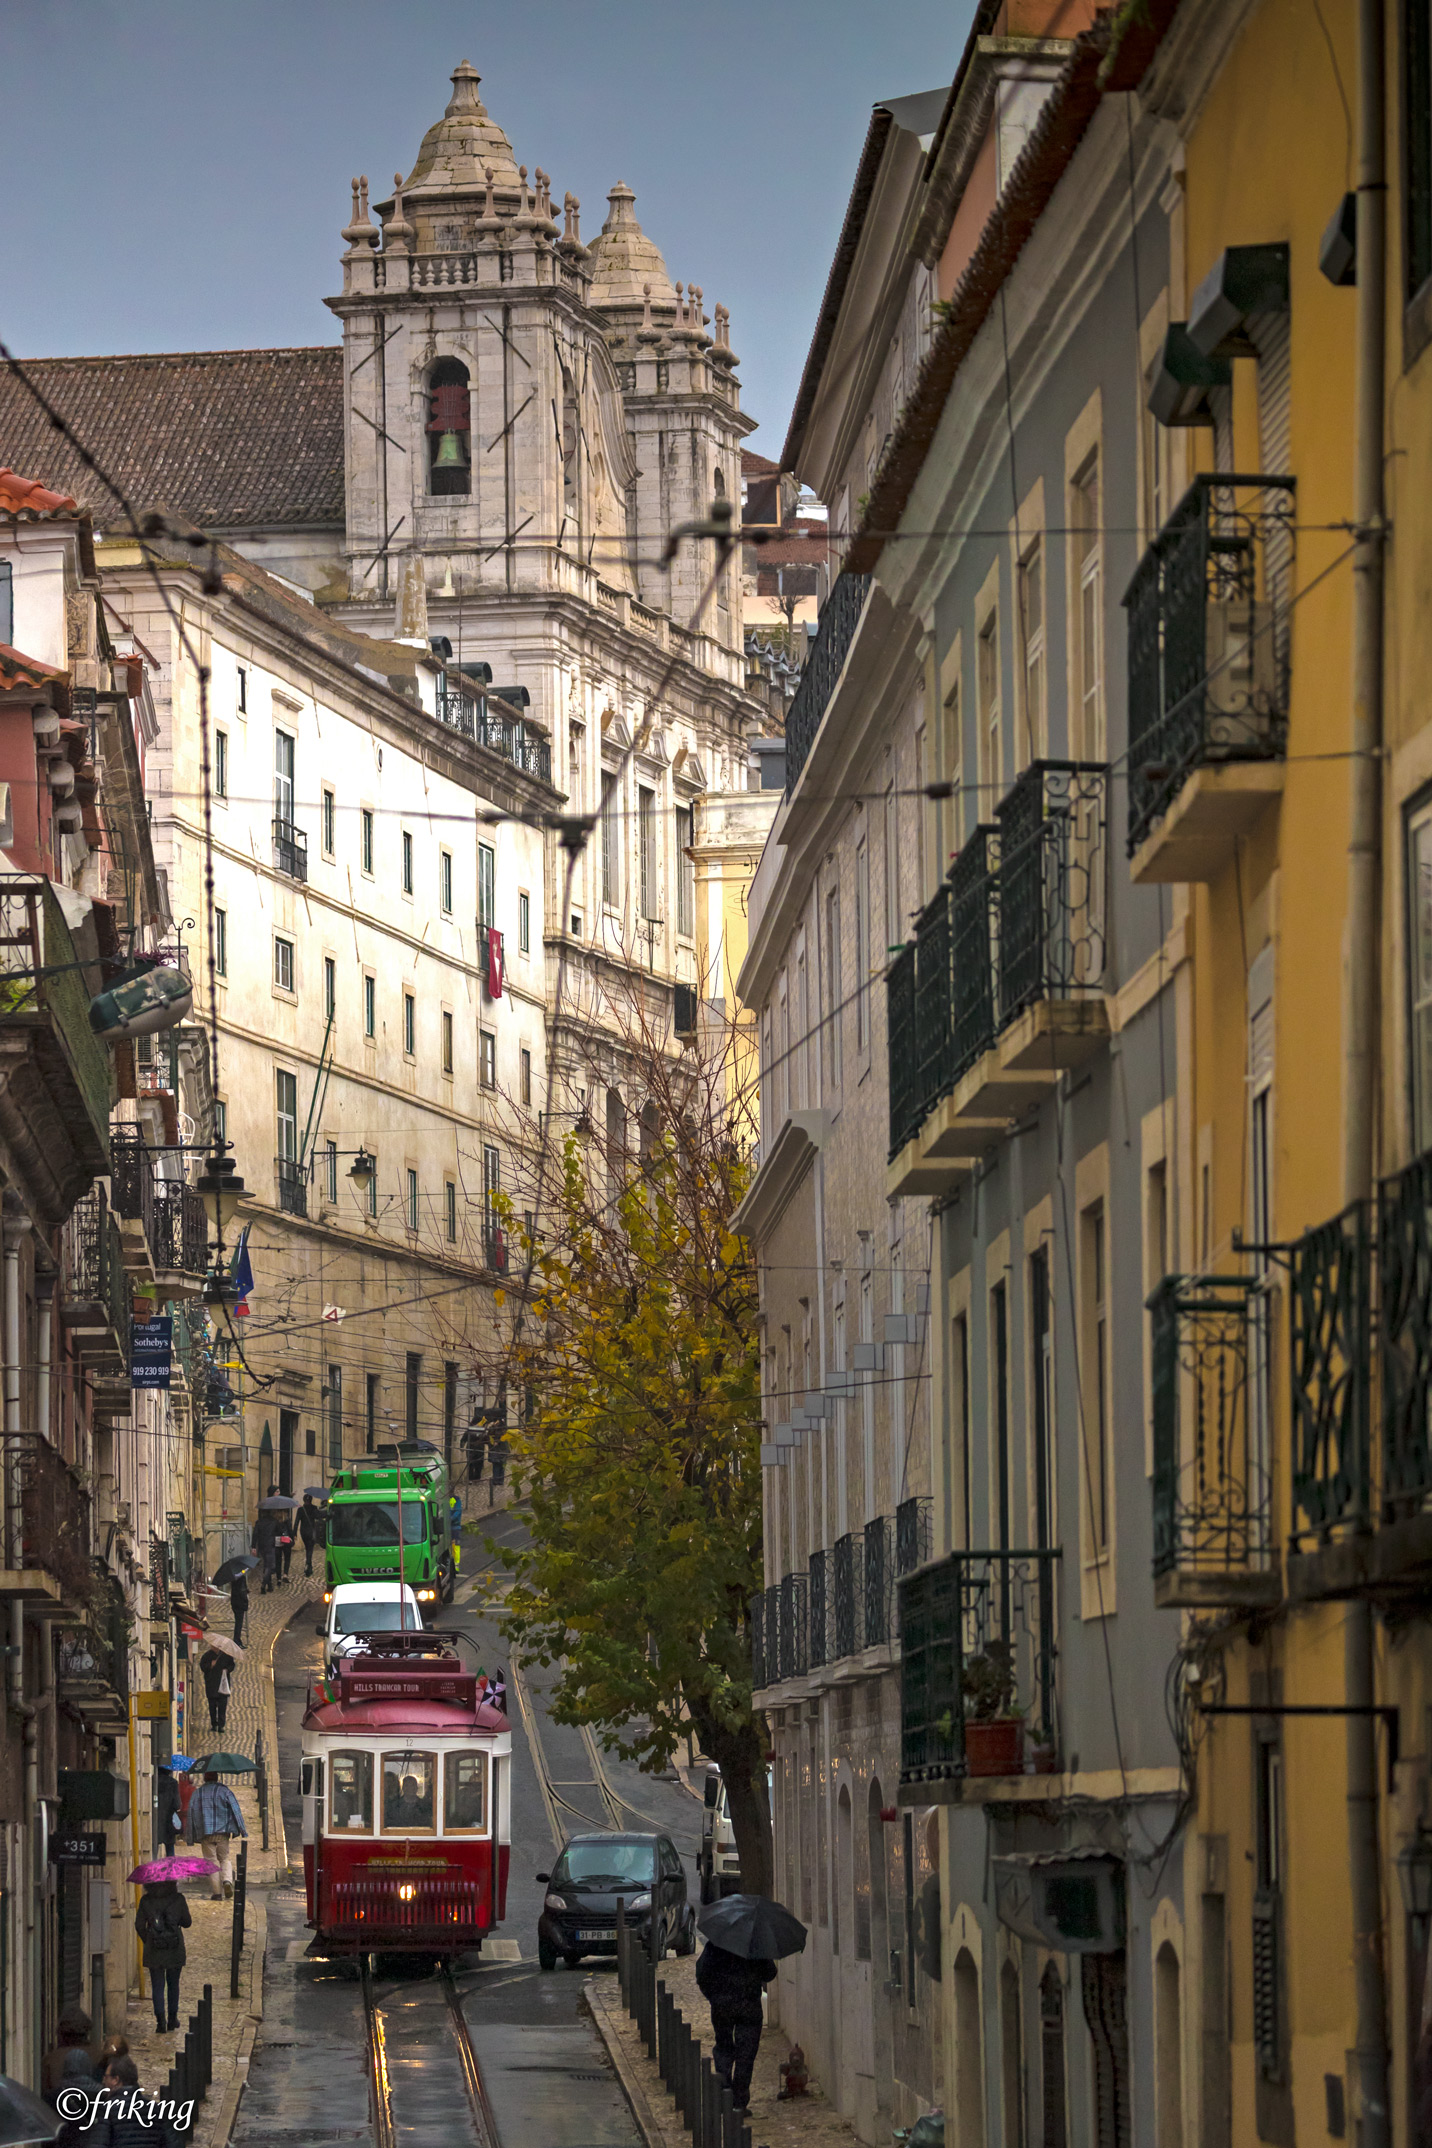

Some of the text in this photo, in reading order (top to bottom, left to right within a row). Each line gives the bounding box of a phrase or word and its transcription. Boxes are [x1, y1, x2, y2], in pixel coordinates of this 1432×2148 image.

[134, 1337, 169, 1348] Sotheby's
[133, 1366, 169, 1376] 919 230 919
[354, 1683, 373, 1692] HILLS
[403, 1684, 420, 1692] TOUR
[64, 1840, 94, 1853] +351
